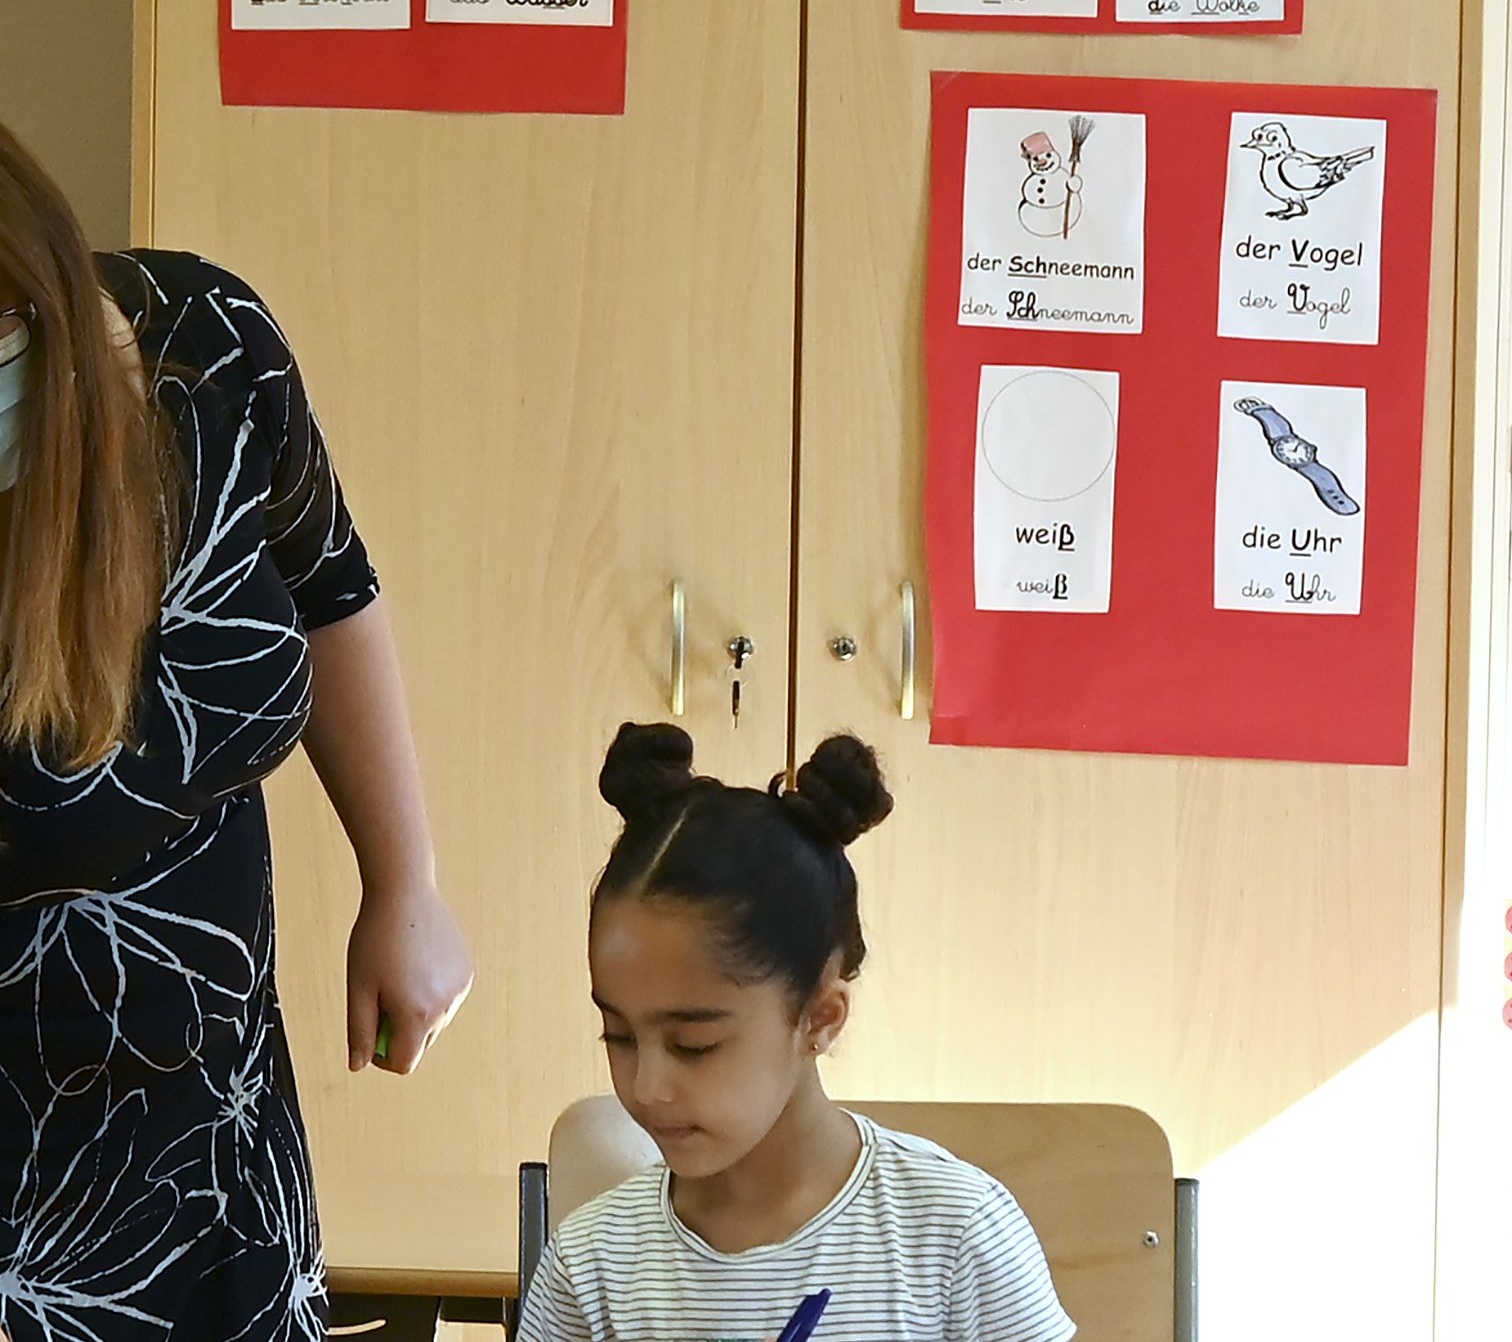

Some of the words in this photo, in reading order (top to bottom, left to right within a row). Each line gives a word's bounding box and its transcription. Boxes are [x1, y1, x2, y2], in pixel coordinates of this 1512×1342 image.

[967, 254, 1003, 273] der
[1008, 255, 1135, 280] Schneemann
[1235, 235, 1281, 260] der
[1290, 238, 1363, 272] Vogel
[961, 299, 998, 318] der
[1007, 291, 1134, 325] Schneemann
[1238, 290, 1278, 310] der
[1286, 283, 1351, 330] Vogel
[1015, 522, 1075, 551] weiß
[1242, 524, 1282, 551] die
[1290, 529, 1343, 554] Uhr
[1016, 573, 1068, 599] weiß
[1241, 581, 1275, 600] die
[1284, 572, 1336, 603] Uhr
